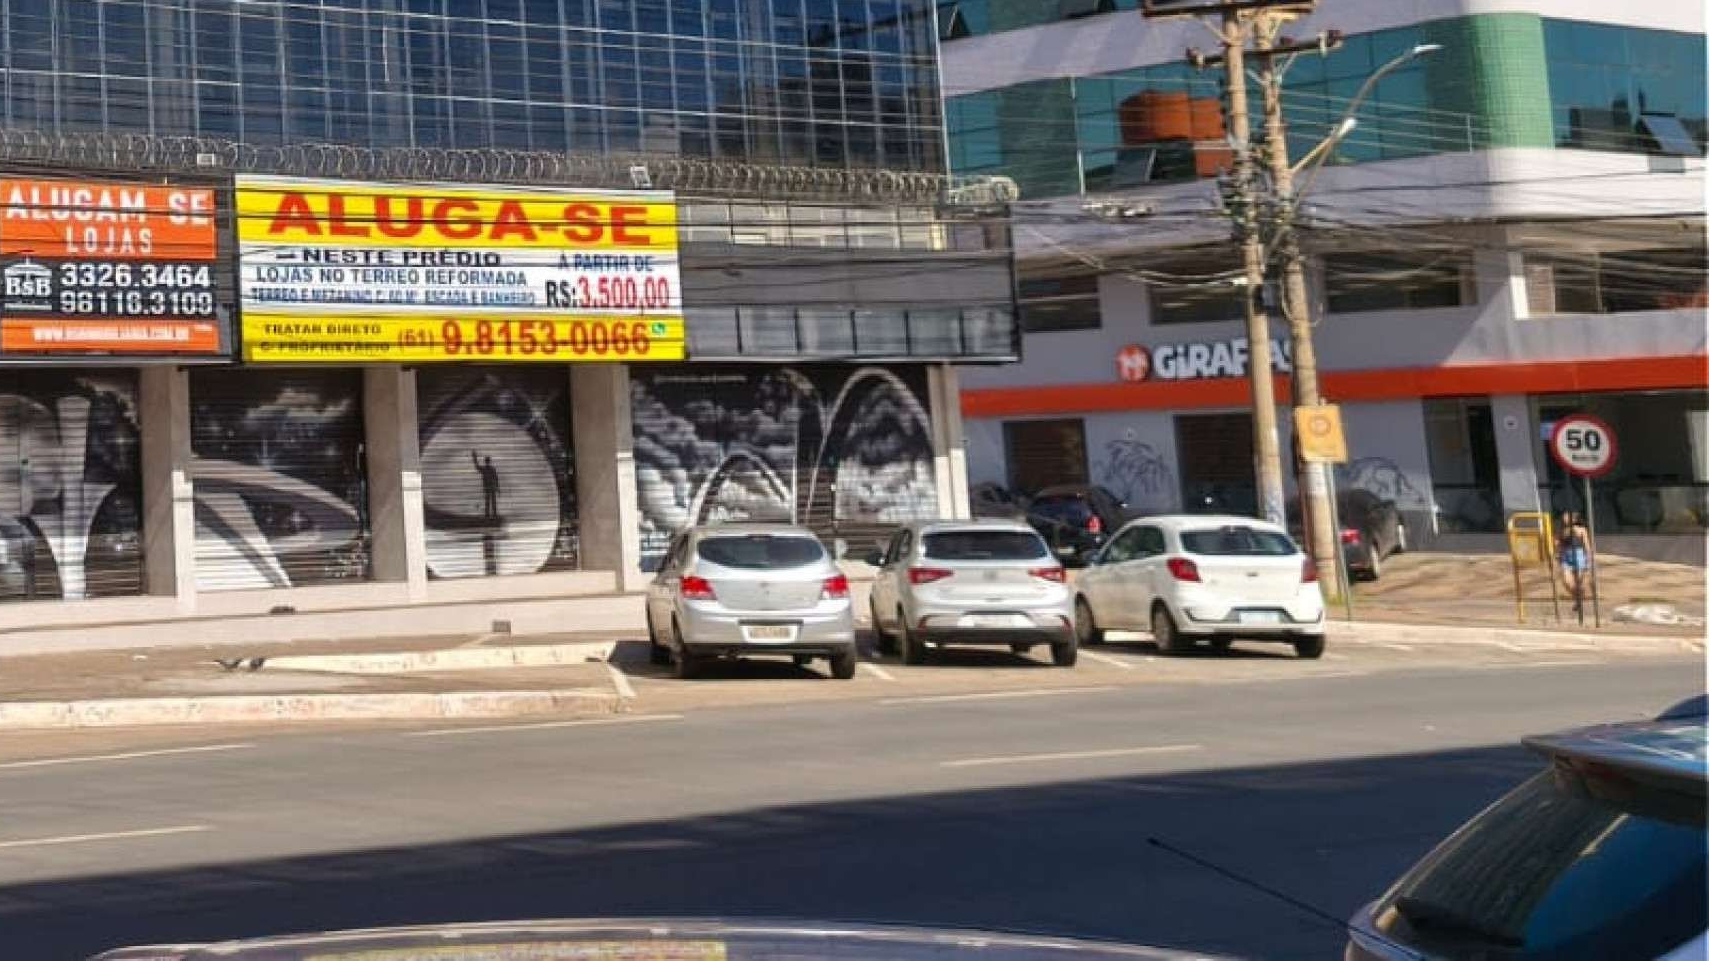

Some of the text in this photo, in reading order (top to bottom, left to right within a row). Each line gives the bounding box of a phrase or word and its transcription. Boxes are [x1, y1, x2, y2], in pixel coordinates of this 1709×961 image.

[169, 192, 209, 225] SE
[268, 192, 650, 246] ALUGA-SE
[66, 226, 152, 254] LOJAS
[60, 262, 210, 288] 3326.3464
[255, 266, 313, 283] LOJAS
[319, 268, 345, 283] NO
[425, 269, 527, 287] REFORMADA
[443, 320, 650, 355] 9.8153-0066
[1566, 429, 1600, 451] 50
